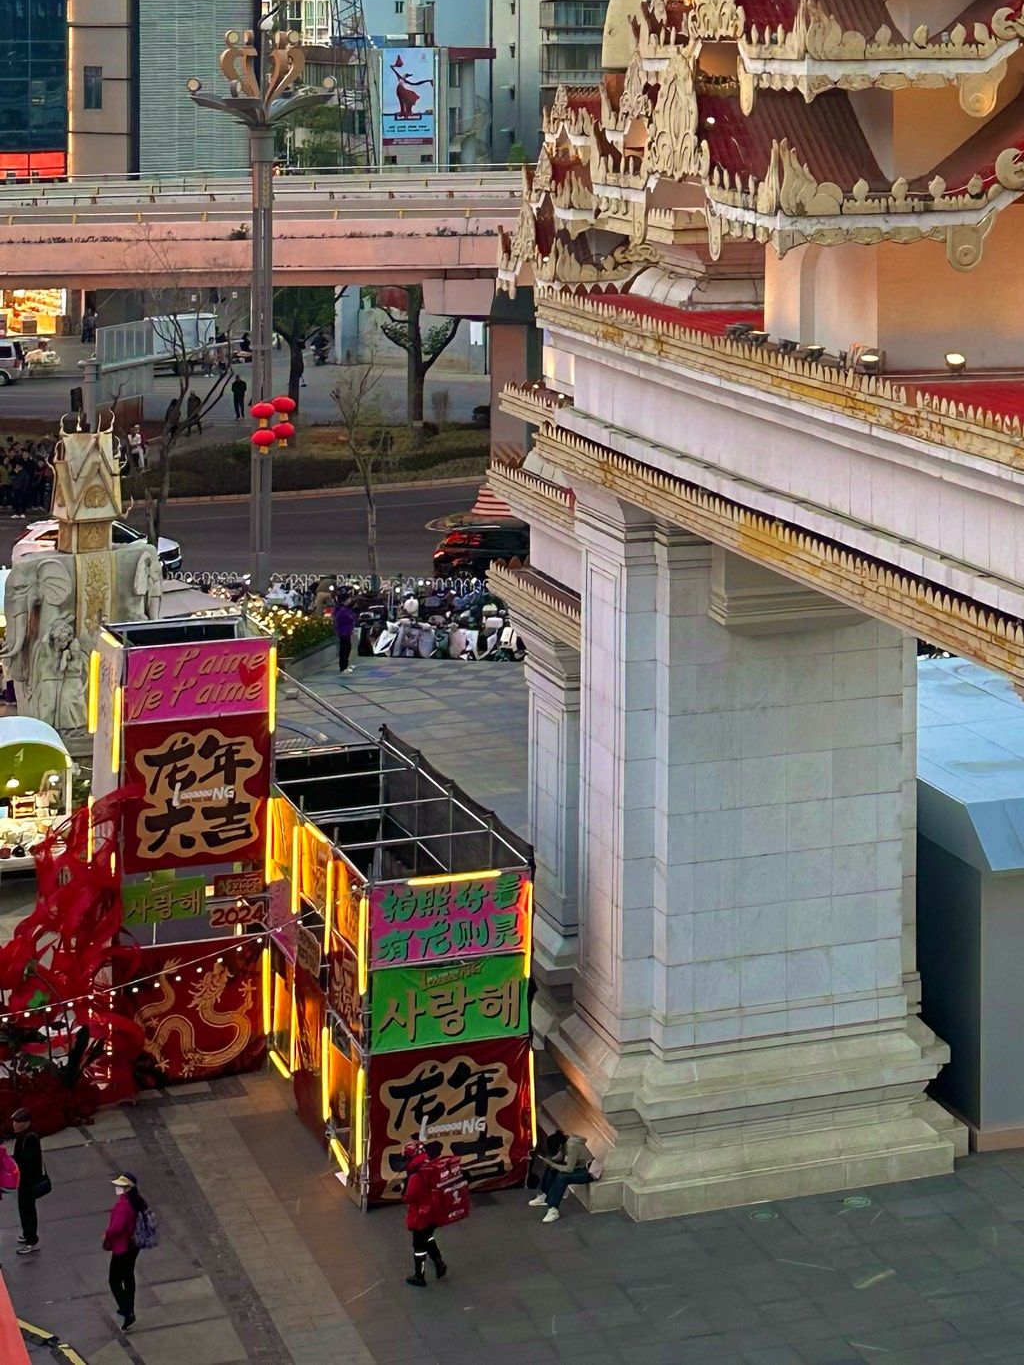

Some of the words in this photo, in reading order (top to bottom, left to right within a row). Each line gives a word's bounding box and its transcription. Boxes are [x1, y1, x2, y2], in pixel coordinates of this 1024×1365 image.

[134, 657, 167, 690] je
[131, 686, 164, 720] je
[143, 734, 256, 796] 龙年
[144, 796, 254, 853] 大吉
[127, 887, 205, 923] 사랑해
[211, 902, 266, 926] 2024
[380, 873, 522, 924] 拍照好看
[376, 913, 523, 962] 有龙则灵
[378, 977, 522, 1043] 사랑해
[388, 1061, 509, 1131] 龙年
